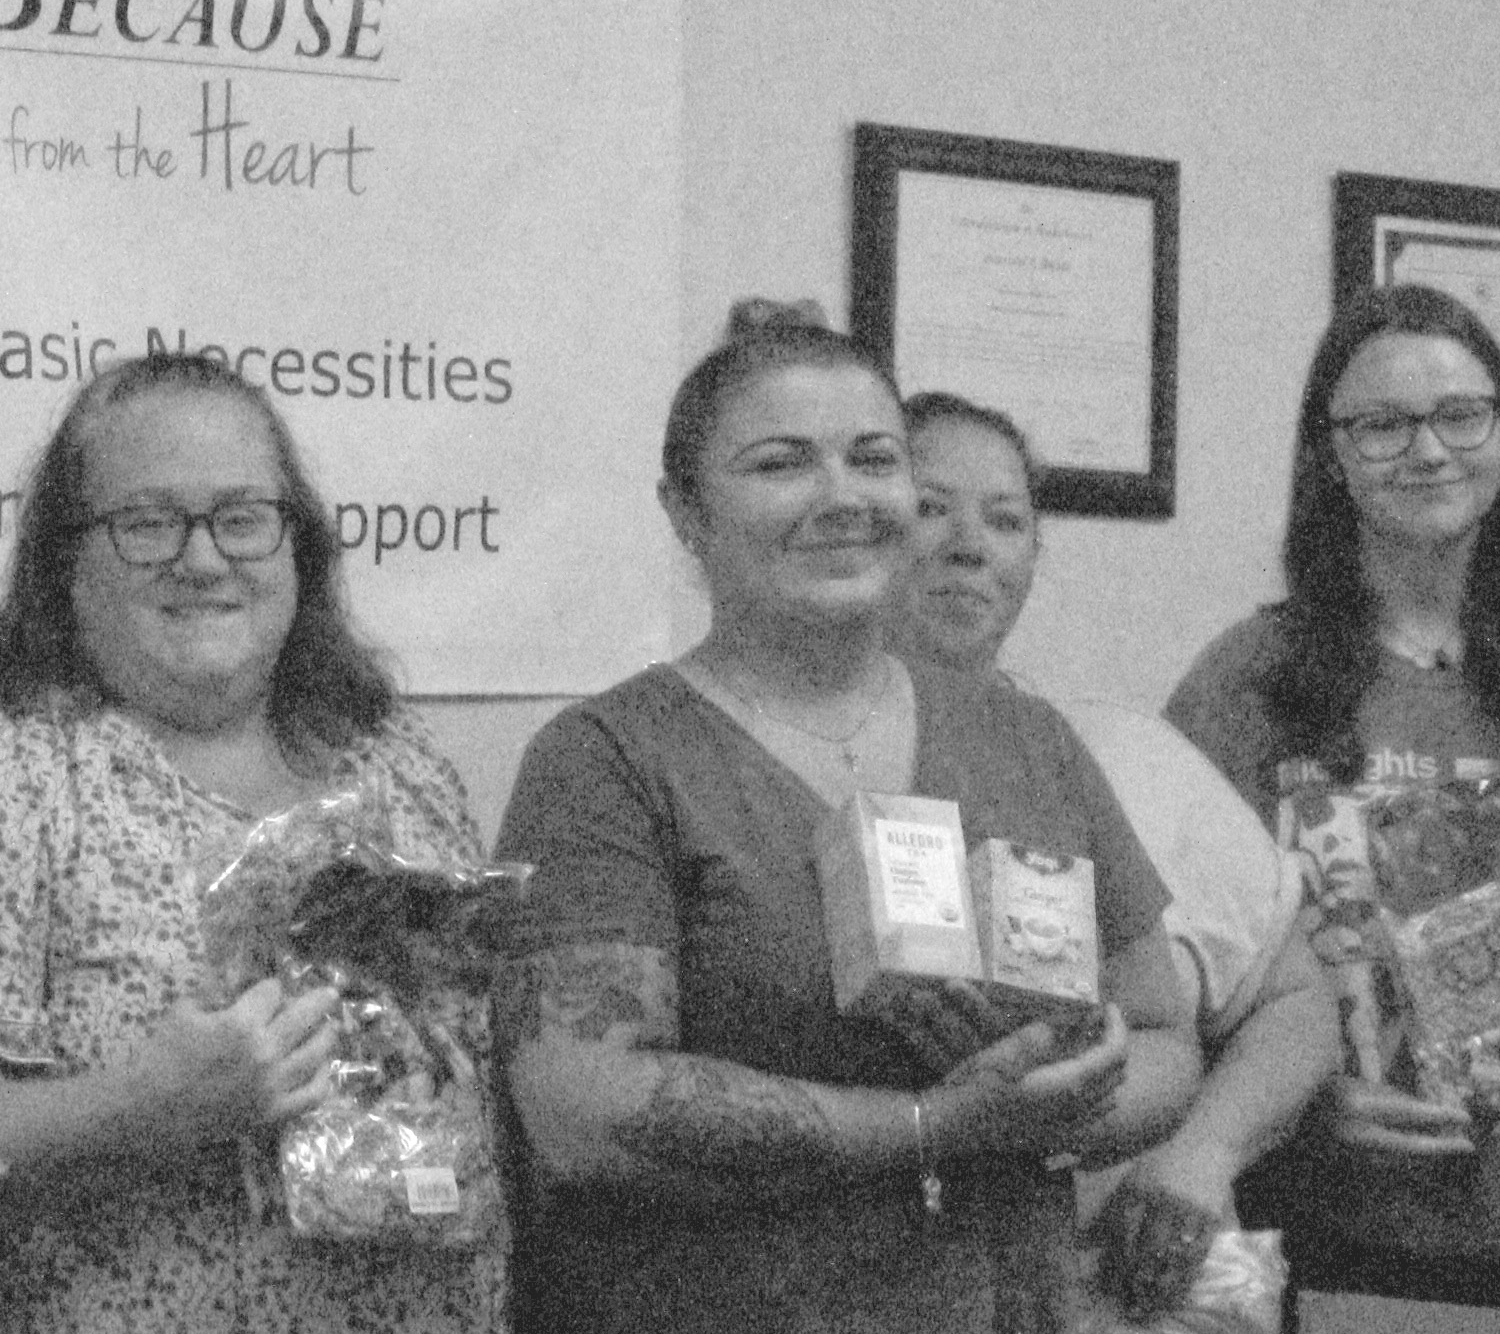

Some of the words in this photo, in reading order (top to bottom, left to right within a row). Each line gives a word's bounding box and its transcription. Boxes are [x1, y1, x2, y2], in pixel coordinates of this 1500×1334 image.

[0, 106, 89, 176] from
[106, 106, 178, 179] the
[189, 79, 375, 195] Heart
[335, 495, 500, 566] pport
